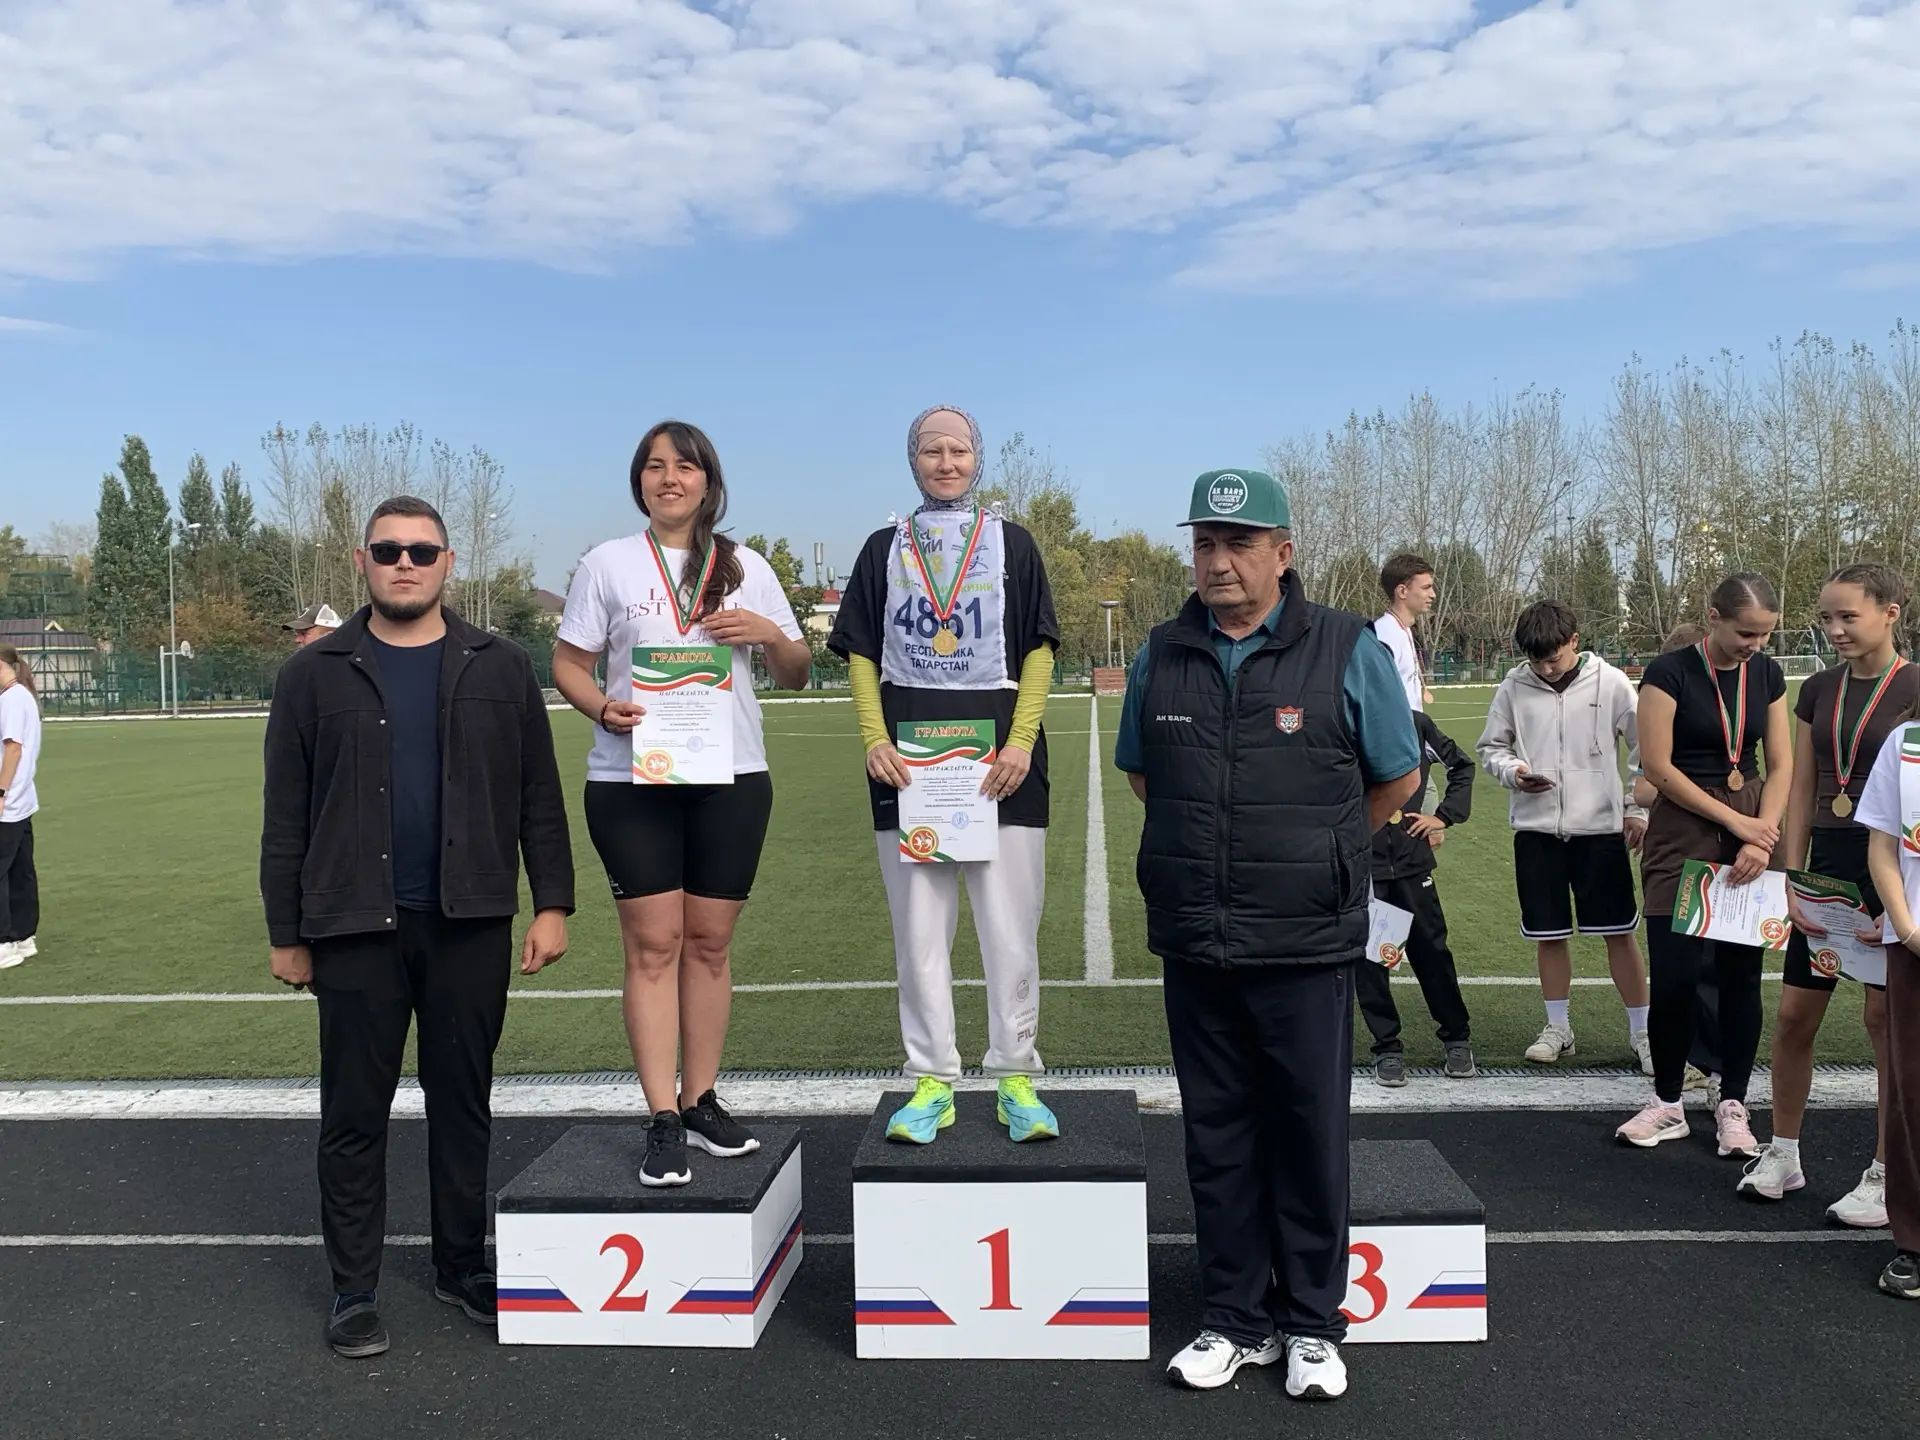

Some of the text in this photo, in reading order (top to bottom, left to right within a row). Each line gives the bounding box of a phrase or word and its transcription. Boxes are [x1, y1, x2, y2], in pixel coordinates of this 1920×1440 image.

[625, 601, 667, 622] EST
[893, 594, 982, 640] 4861
[650, 651, 715, 664] ГРАМОТА
[910, 657, 970, 672] ТАТАРСТАН
[914, 726, 977, 738] ГРАМОТА
[599, 1233, 649, 1313] 2
[977, 1227, 1023, 1311] 1
[1338, 1242, 1388, 1325] 3
